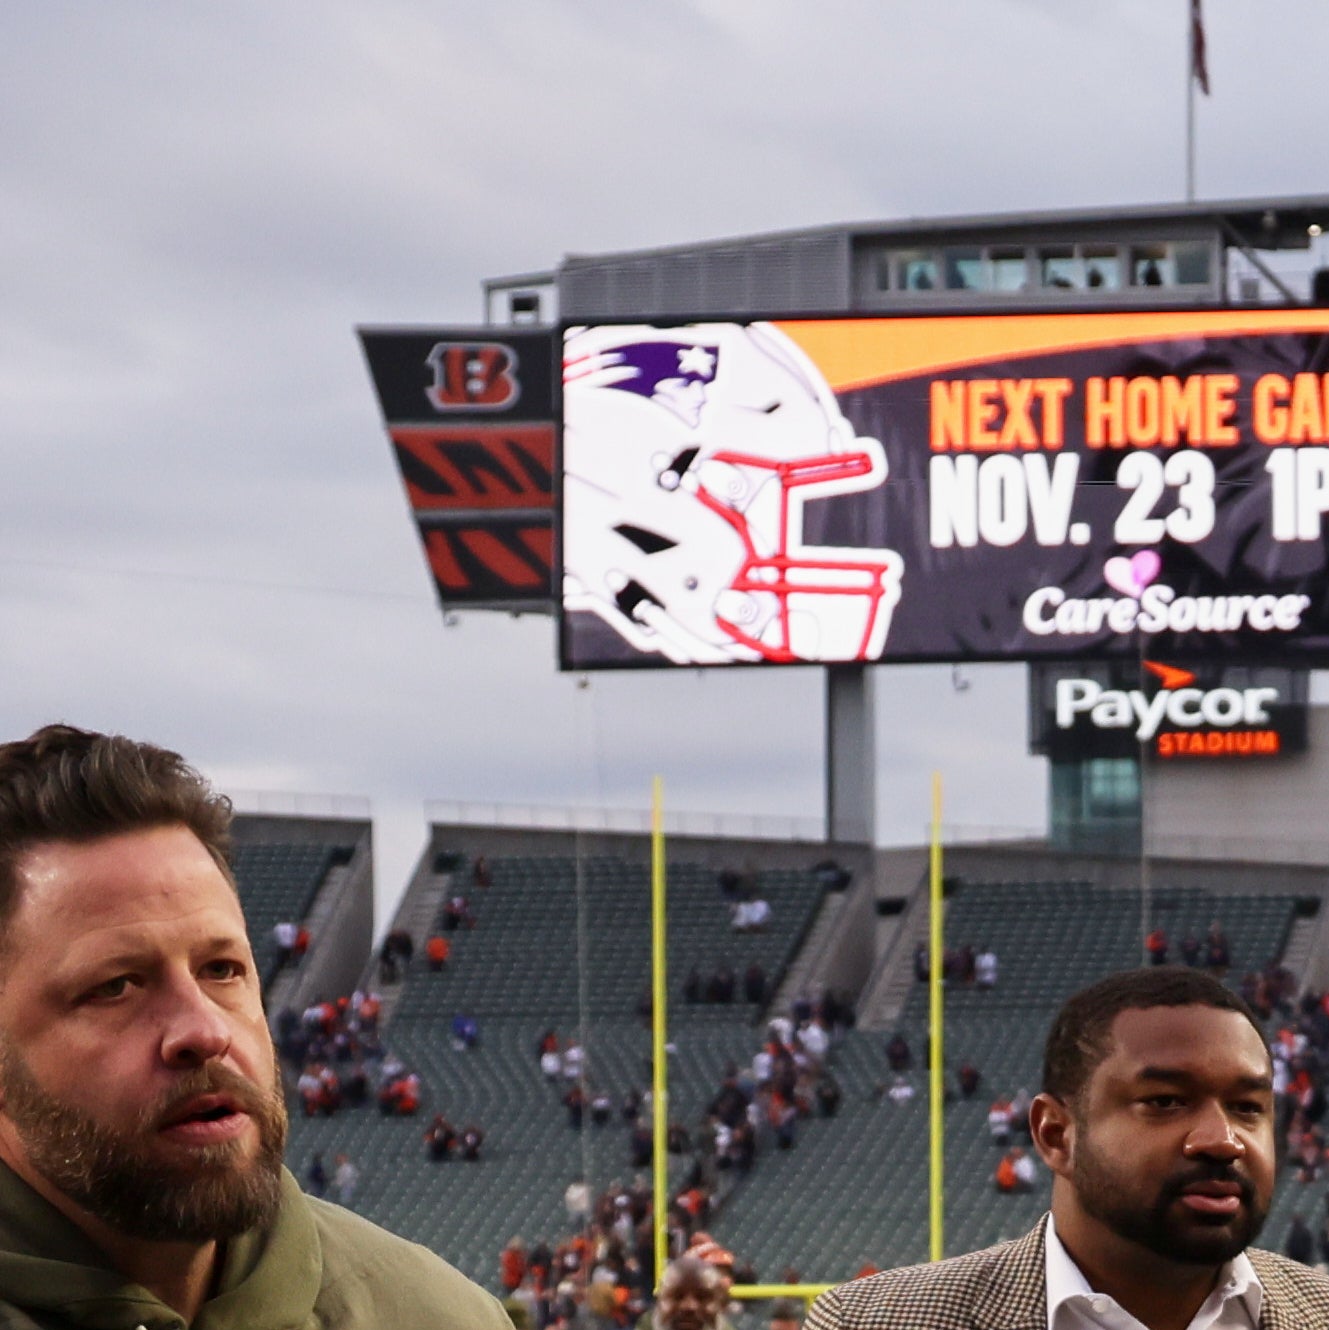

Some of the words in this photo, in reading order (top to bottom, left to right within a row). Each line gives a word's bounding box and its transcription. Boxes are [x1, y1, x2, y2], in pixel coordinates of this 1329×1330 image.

[929, 378, 1073, 452] NEXT
[1086, 374, 1240, 449] HOME
[929, 452, 1091, 548] NOV.
[1114, 449, 1216, 544] 23
[1023, 584, 1310, 635] CareSource
[1056, 678, 1279, 741] Paycor
[1157, 730, 1280, 758] STADIUM
